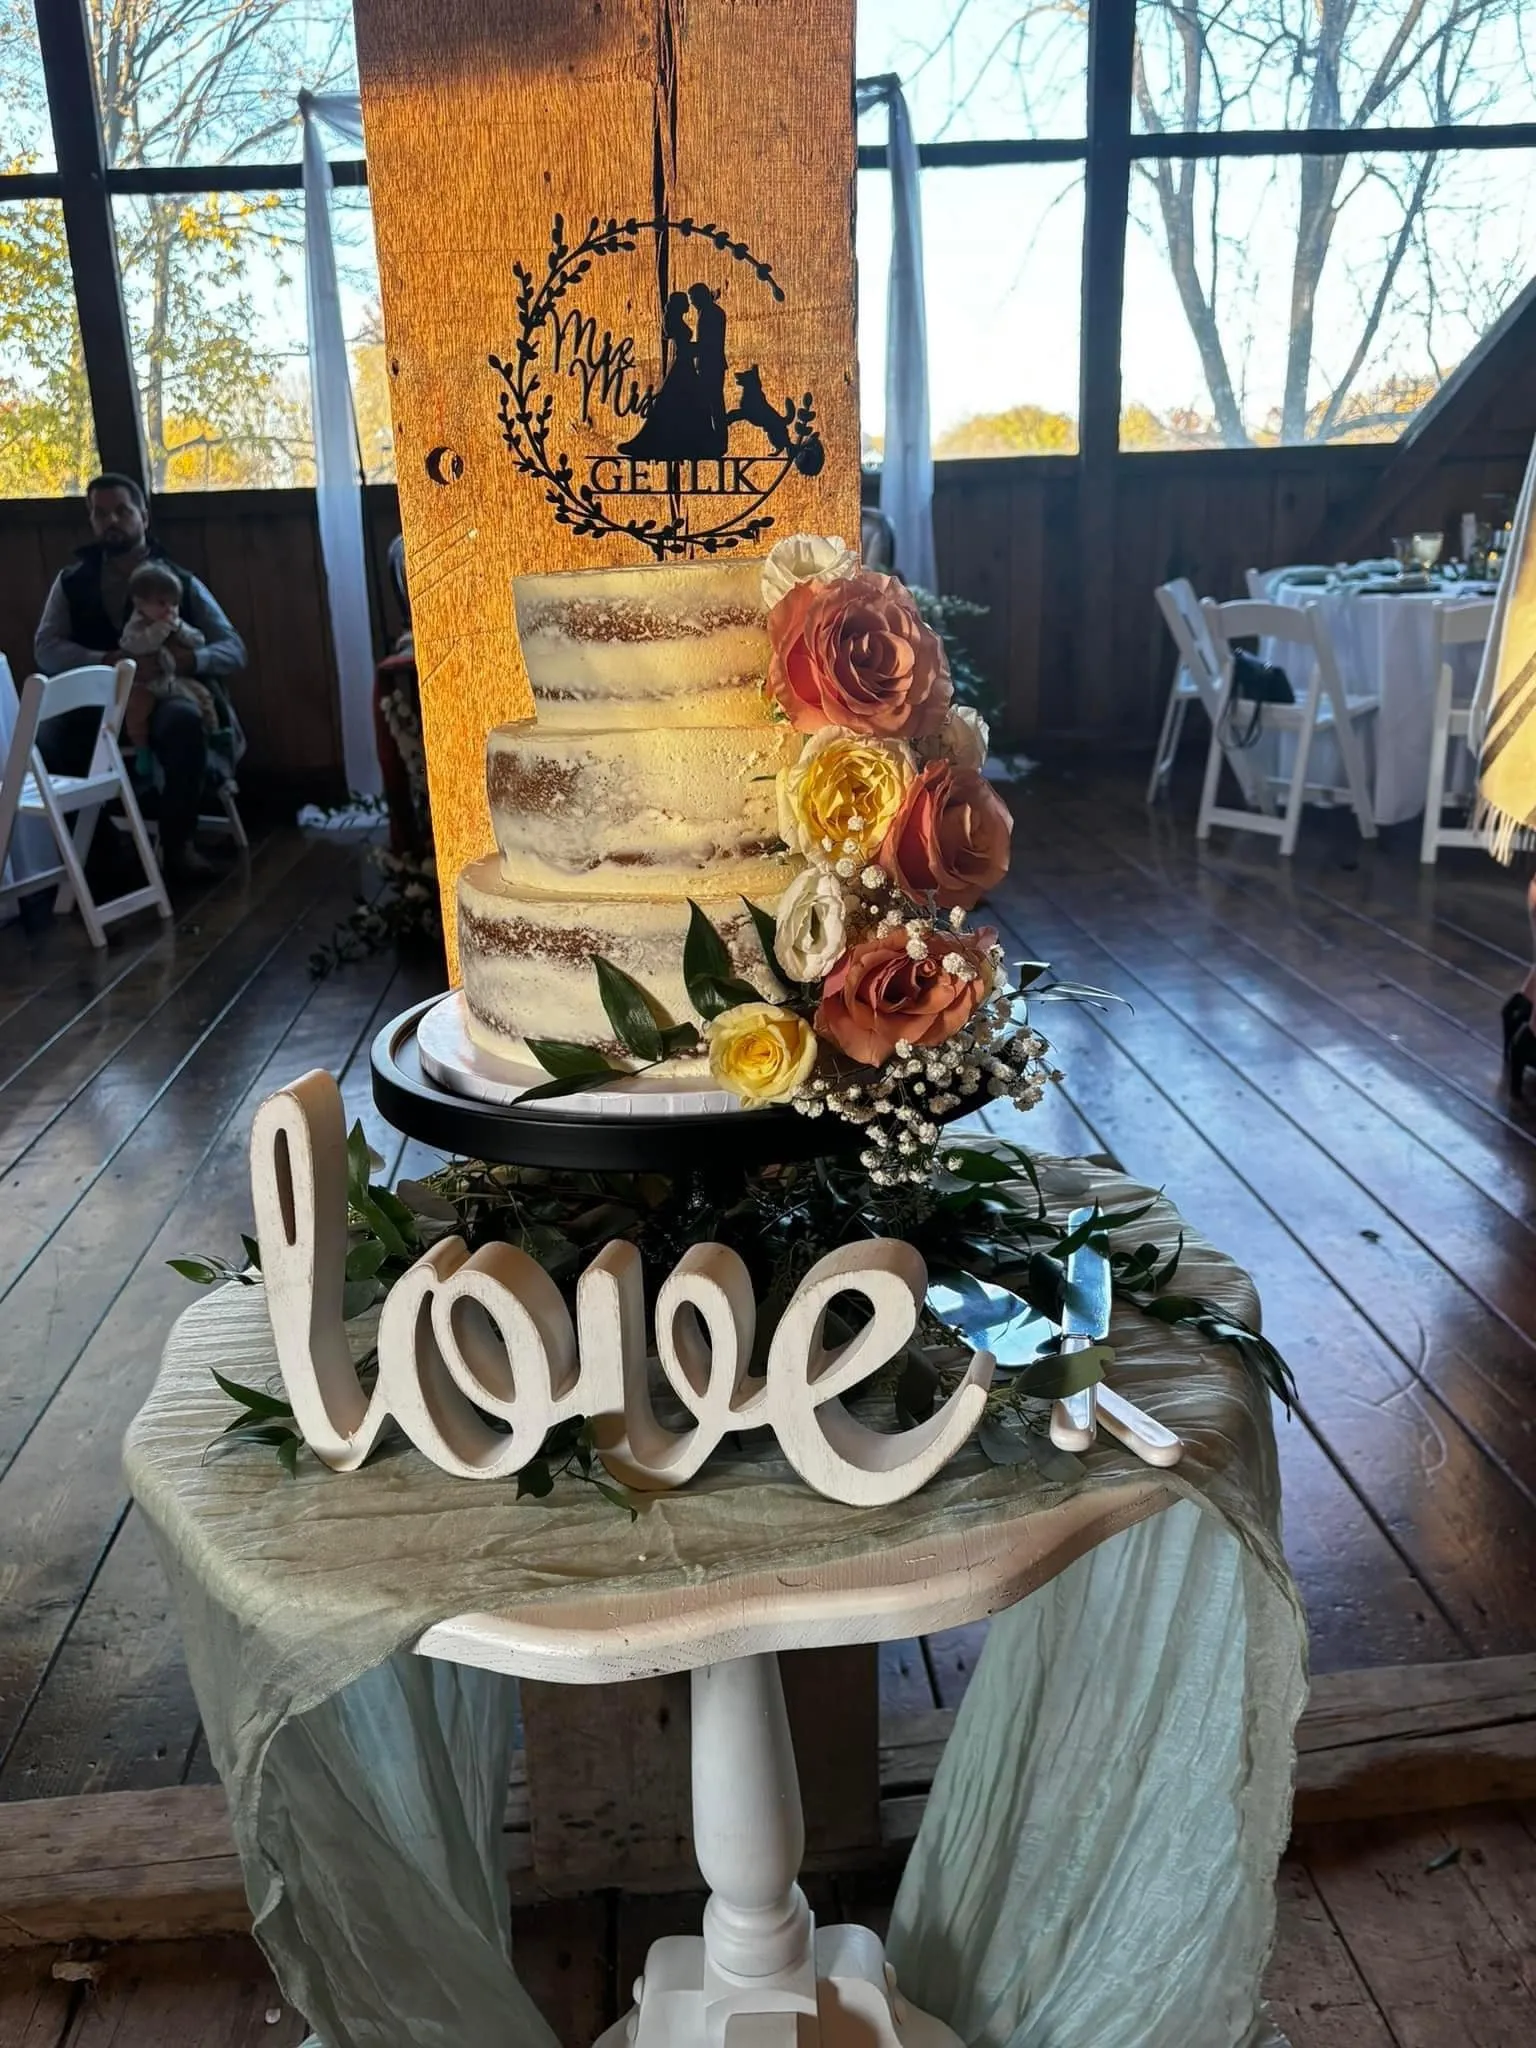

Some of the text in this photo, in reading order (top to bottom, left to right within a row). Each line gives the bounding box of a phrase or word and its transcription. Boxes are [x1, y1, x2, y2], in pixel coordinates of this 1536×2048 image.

[547, 309, 612, 373] Mr
[568, 358, 662, 421] Mrs
[250, 1068, 996, 1508] love
